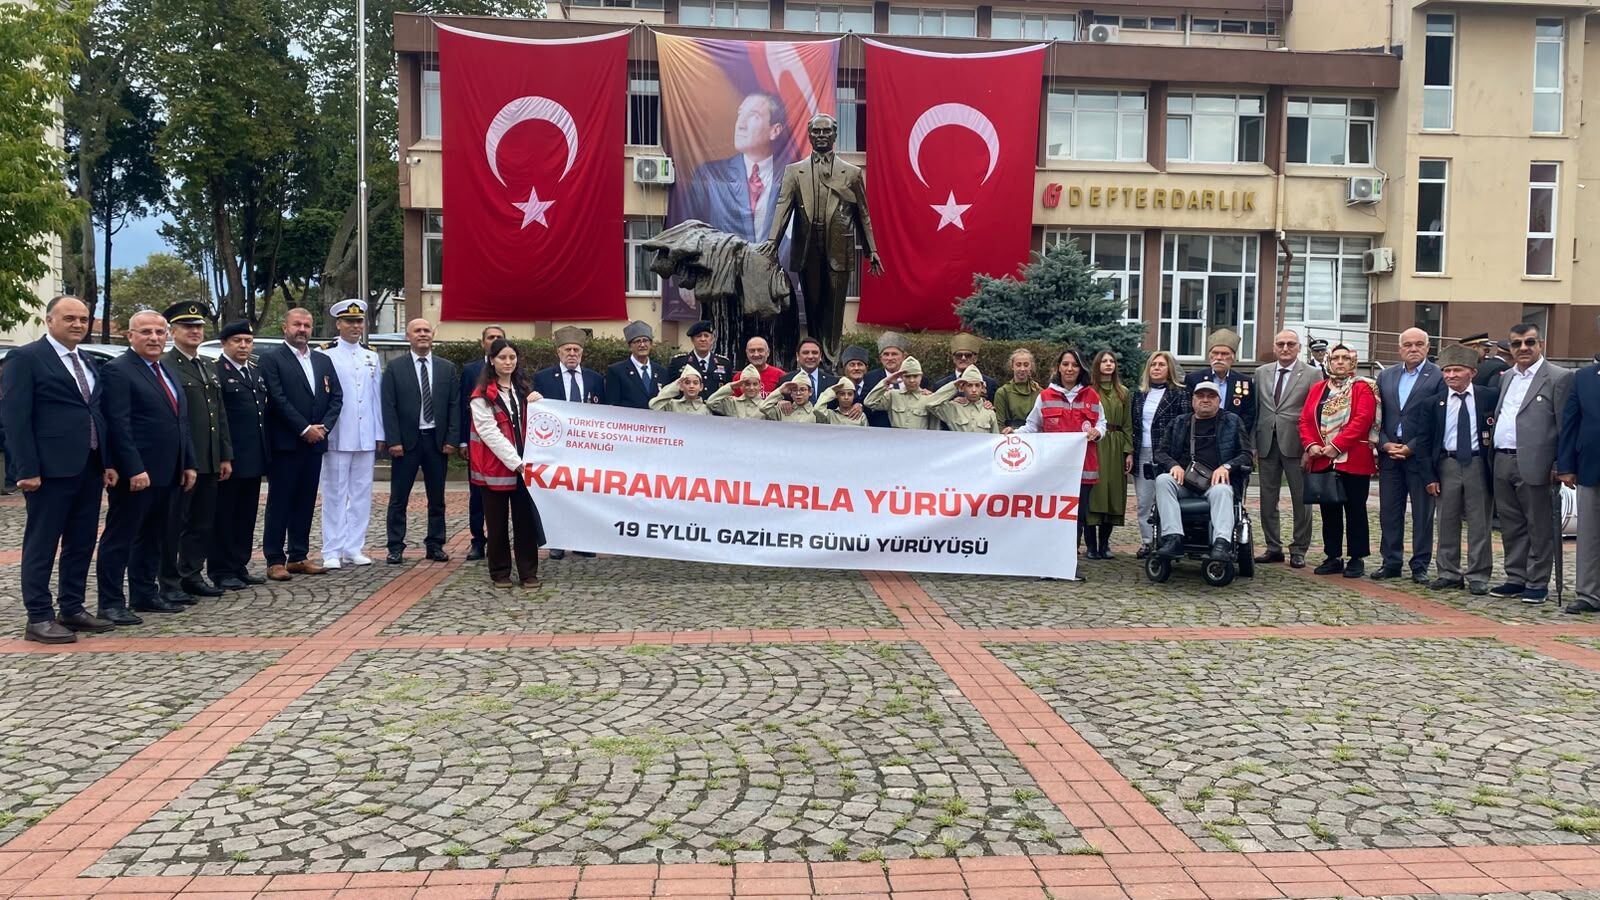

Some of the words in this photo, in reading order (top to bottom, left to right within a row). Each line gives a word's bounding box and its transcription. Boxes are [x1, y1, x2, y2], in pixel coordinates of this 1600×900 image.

[1069, 186, 1256, 210] DEFTERDARLIK
[568, 418, 605, 429] TÜRKİYE
[606, 421, 666, 434] CUMHURİYETİ
[565, 440, 614, 451] BAKANLIĞI
[567, 428, 586, 438] AİLE
[588, 431, 599, 439] VE
[601, 432, 633, 443] SOSYAL
[636, 434, 684, 446] HİZMETLER
[524, 463, 854, 513] KAHRAMANLARLA
[864, 485, 1079, 521] YÜRÜYORUZ
[614, 520, 640, 537] 19
[646, 522, 711, 543] EYLÜL
[717, 528, 803, 549] GAZİLER
[809, 532, 870, 552] GÜNÜ
[877, 535, 988, 558] YÜRÜYÜŞÜ
